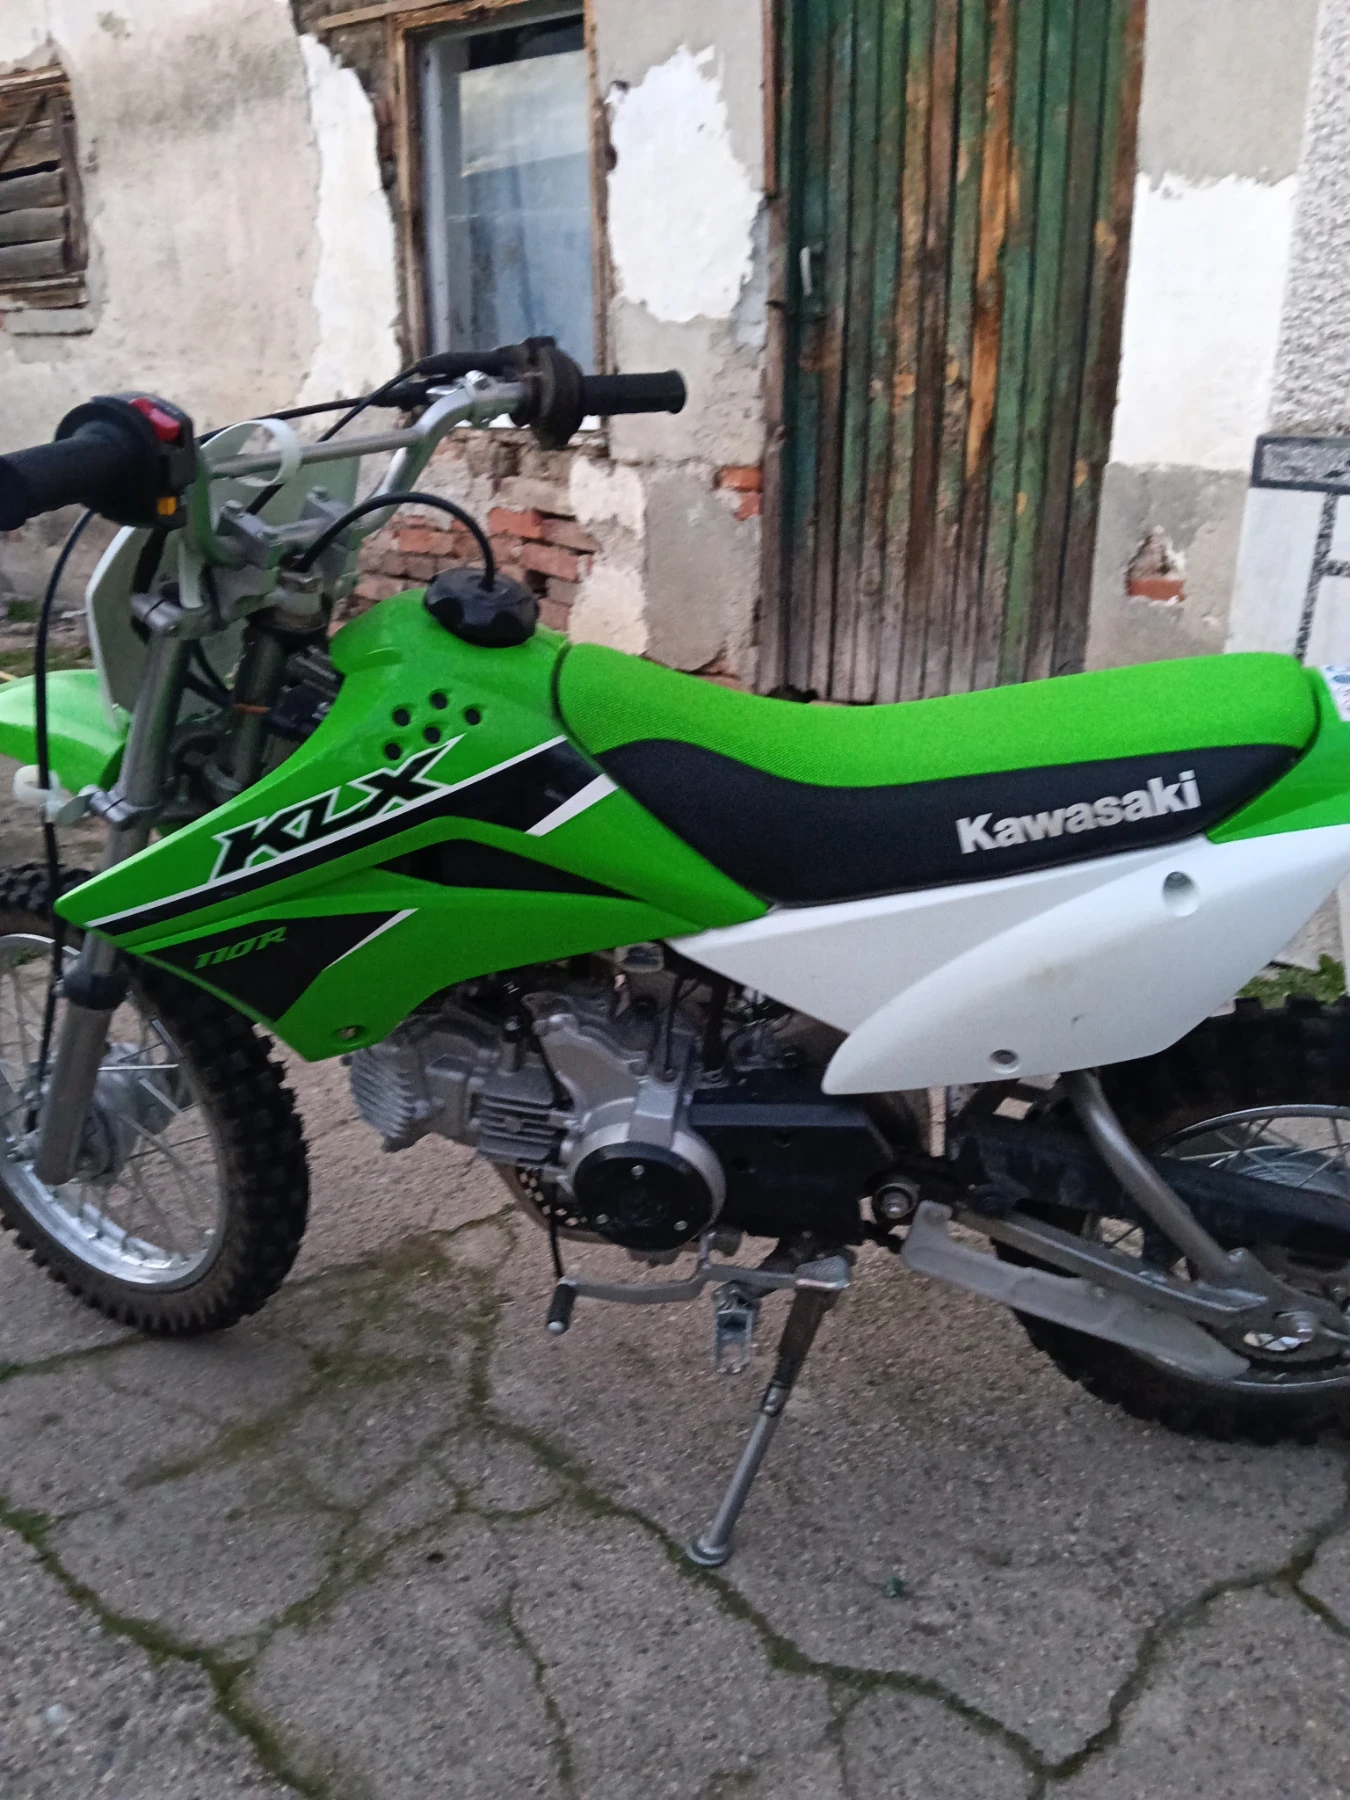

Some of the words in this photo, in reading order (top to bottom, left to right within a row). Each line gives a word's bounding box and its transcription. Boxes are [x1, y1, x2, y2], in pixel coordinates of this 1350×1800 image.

[209, 733, 466, 883] KLX
[956, 770, 1201, 854] Kawasaki
[195, 926, 287, 969] 110R
